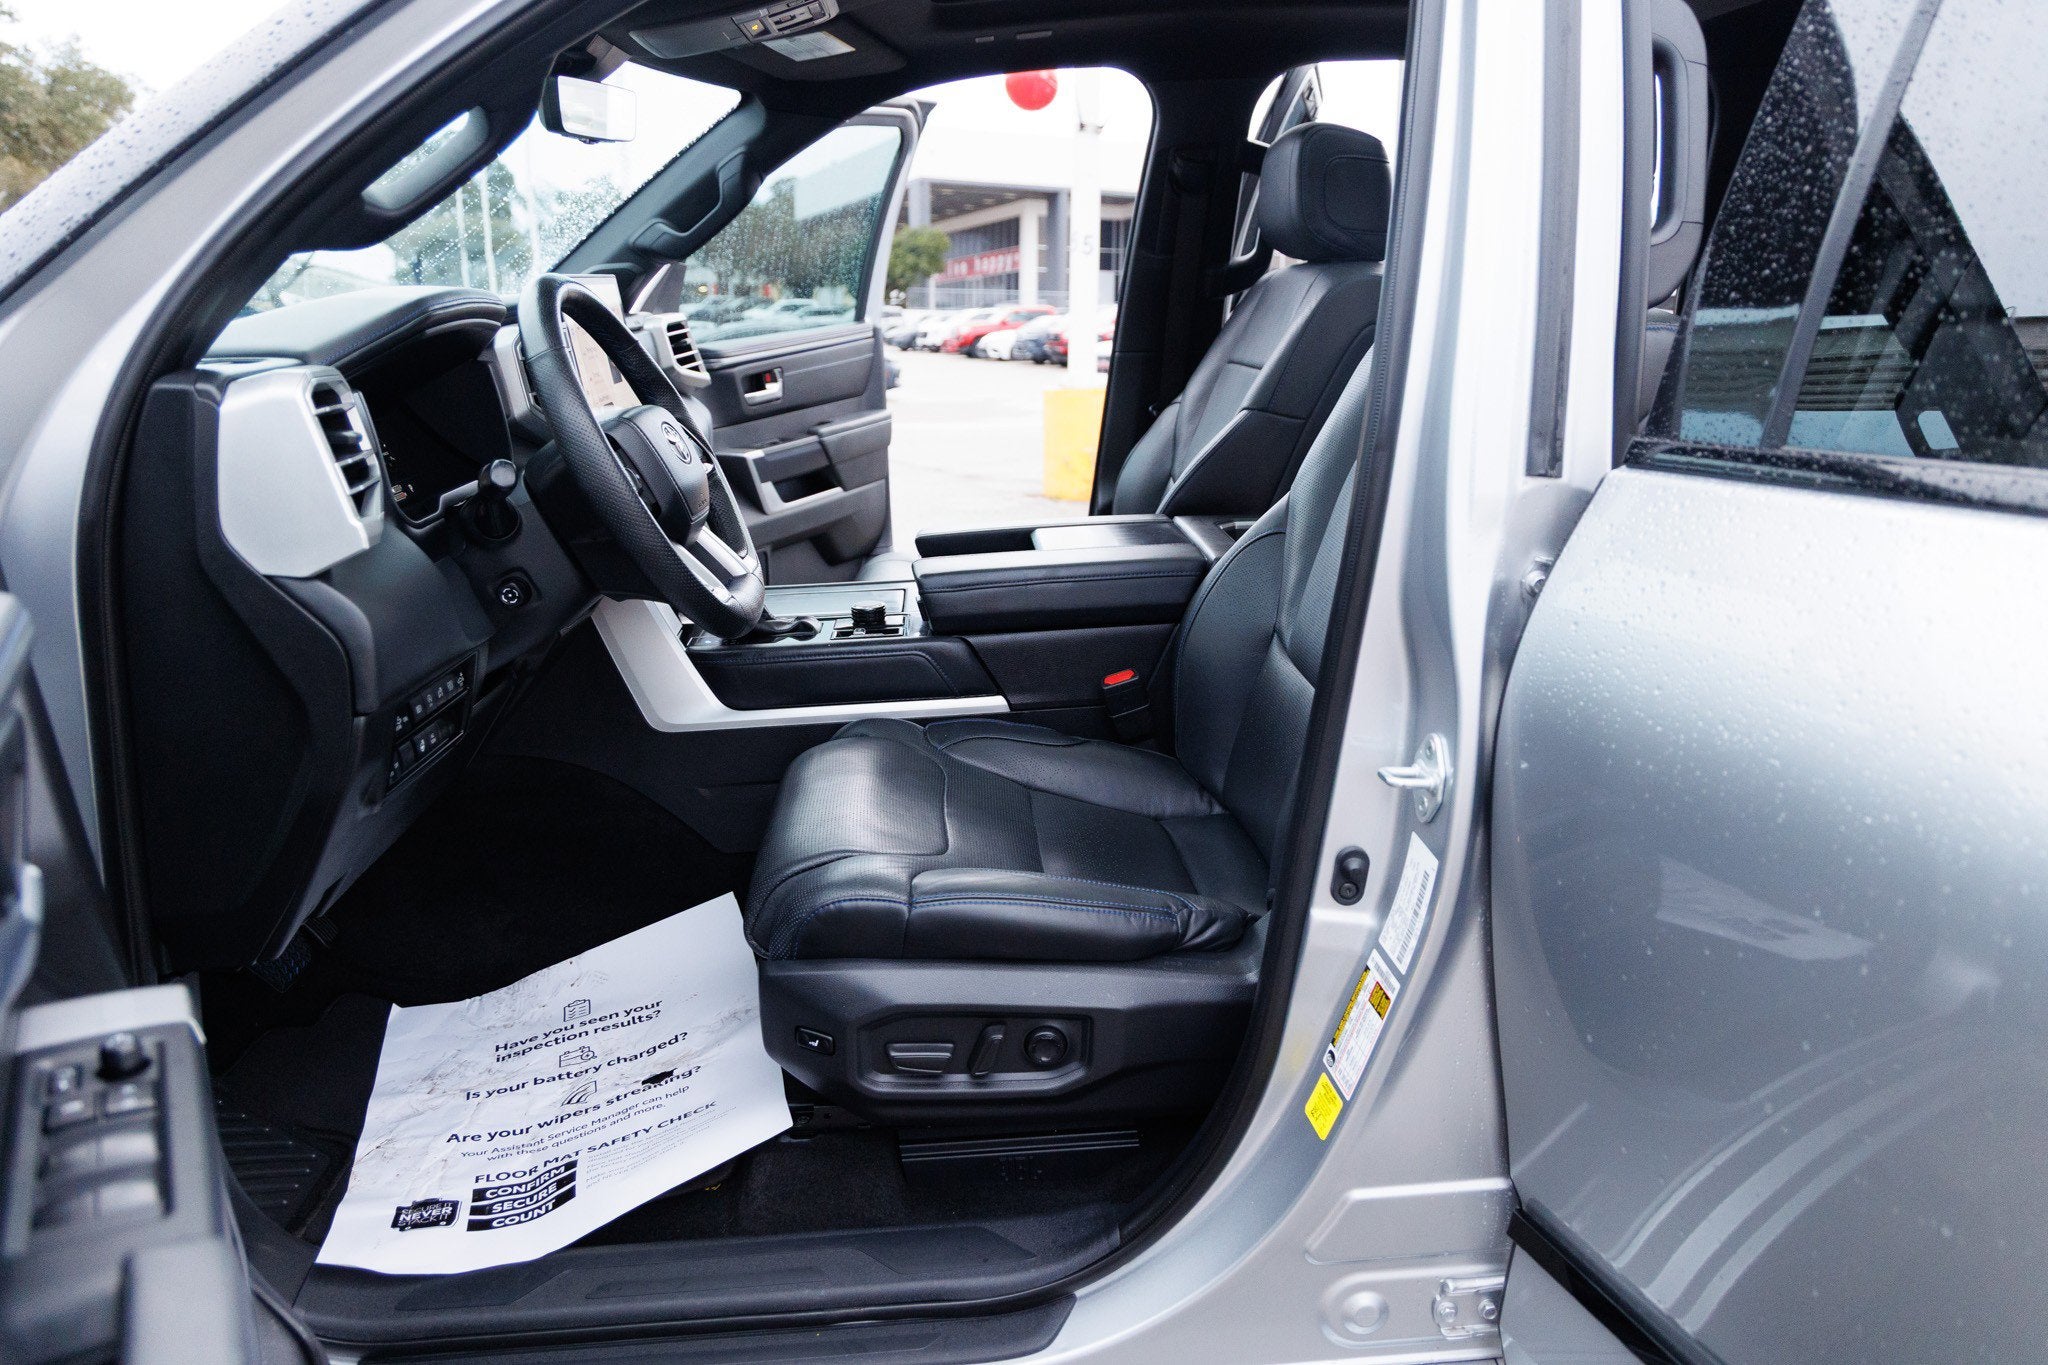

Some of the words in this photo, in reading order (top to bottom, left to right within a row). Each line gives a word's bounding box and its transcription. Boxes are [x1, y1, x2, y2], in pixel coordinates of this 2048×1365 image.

[495, 1034, 539, 1053] Have
[542, 1023, 575, 1040] you
[579, 1012, 619, 1028] seen
[623, 1000, 663, 1018] your
[495, 1028, 589, 1063] inspection
[593, 1009, 662, 1034] results?
[466, 1090, 480, 1101] Is
[485, 1079, 530, 1099] your
[533, 1064, 603, 1086] battery
[606, 1031, 689, 1067] charged?
[446, 1133, 482, 1144] Are
[487, 1125, 533, 1143] your
[537, 1104, 601, 1129] wipers
[461, 1149, 489, 1158] Your
[491, 1138, 545, 1153] Assistant
[547, 1123, 588, 1141] Service
[591, 1103, 640, 1125] Manager
[642, 1096, 663, 1106] can
[665, 1085, 690, 1099] help
[487, 1151, 513, 1162] with
[517, 1144, 549, 1156] these
[551, 1123, 607, 1148] questions
[610, 1113, 632, 1127] and
[634, 1102, 666, 1117] more.
[475, 1165, 538, 1184] FLOOR
[543, 1149, 582, 1168] MAT
[587, 1125, 654, 1154] SAFETY
[657, 1100, 718, 1129] CHECK
[485, 1165, 566, 1199] CONFIRM
[492, 1181, 558, 1213] SECURE
[398, 1215, 438, 1227] STACK
[439, 1213, 450, 1221] IT
[399, 1206, 453, 1221] NEVER
[401, 1202, 442, 1215] SECURE
[491, 1198, 557, 1228] COUNT
